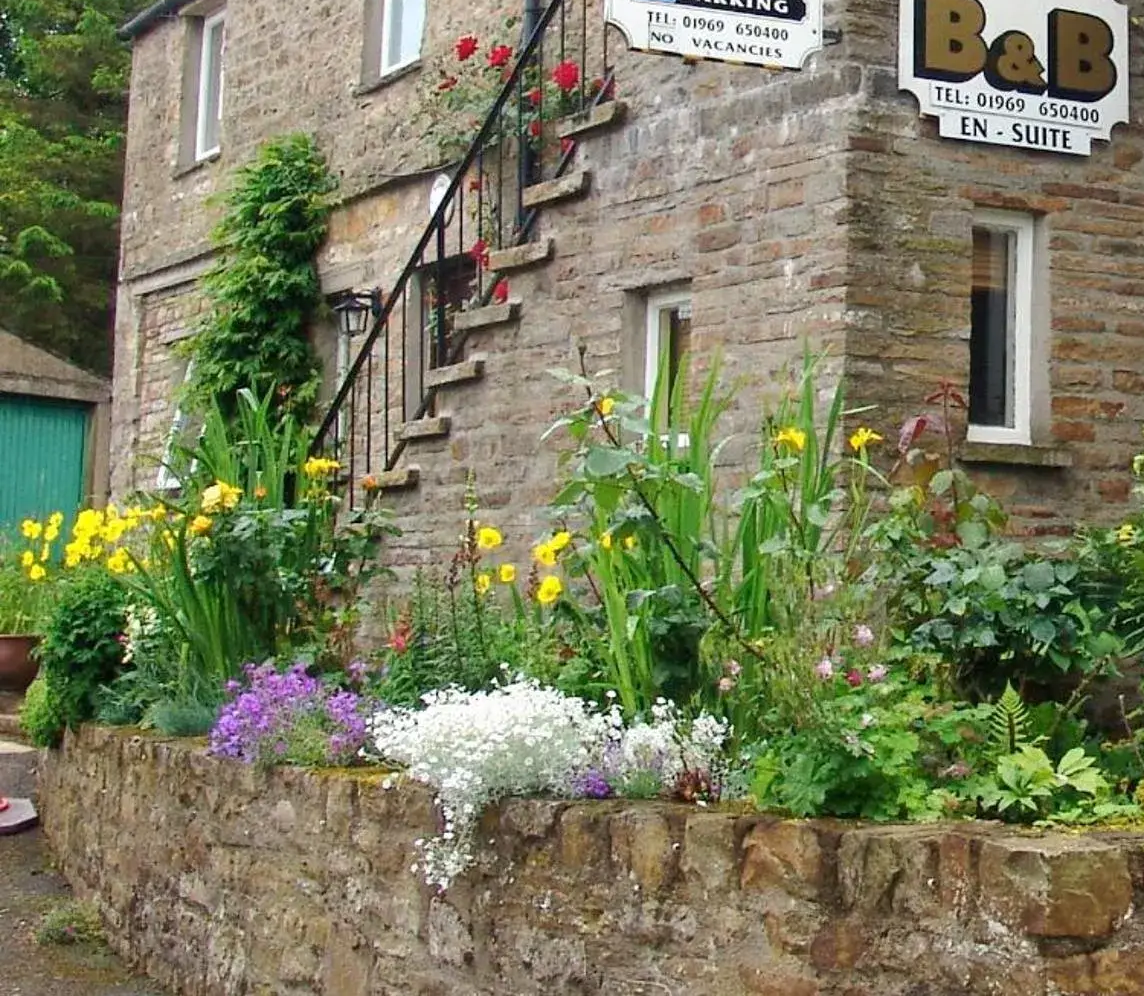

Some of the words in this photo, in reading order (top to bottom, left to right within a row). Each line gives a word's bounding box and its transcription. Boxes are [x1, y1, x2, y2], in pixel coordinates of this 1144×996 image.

[682, 15, 725, 33] 01969
[736, 23, 789, 41] 650400
[651, 31, 674, 44] NO
[691, 37, 783, 58] VACANCIES
[935, 86, 970, 106] TEL:
[976, 92, 1026, 113] 01969
[1039, 101, 1100, 123] 650400
